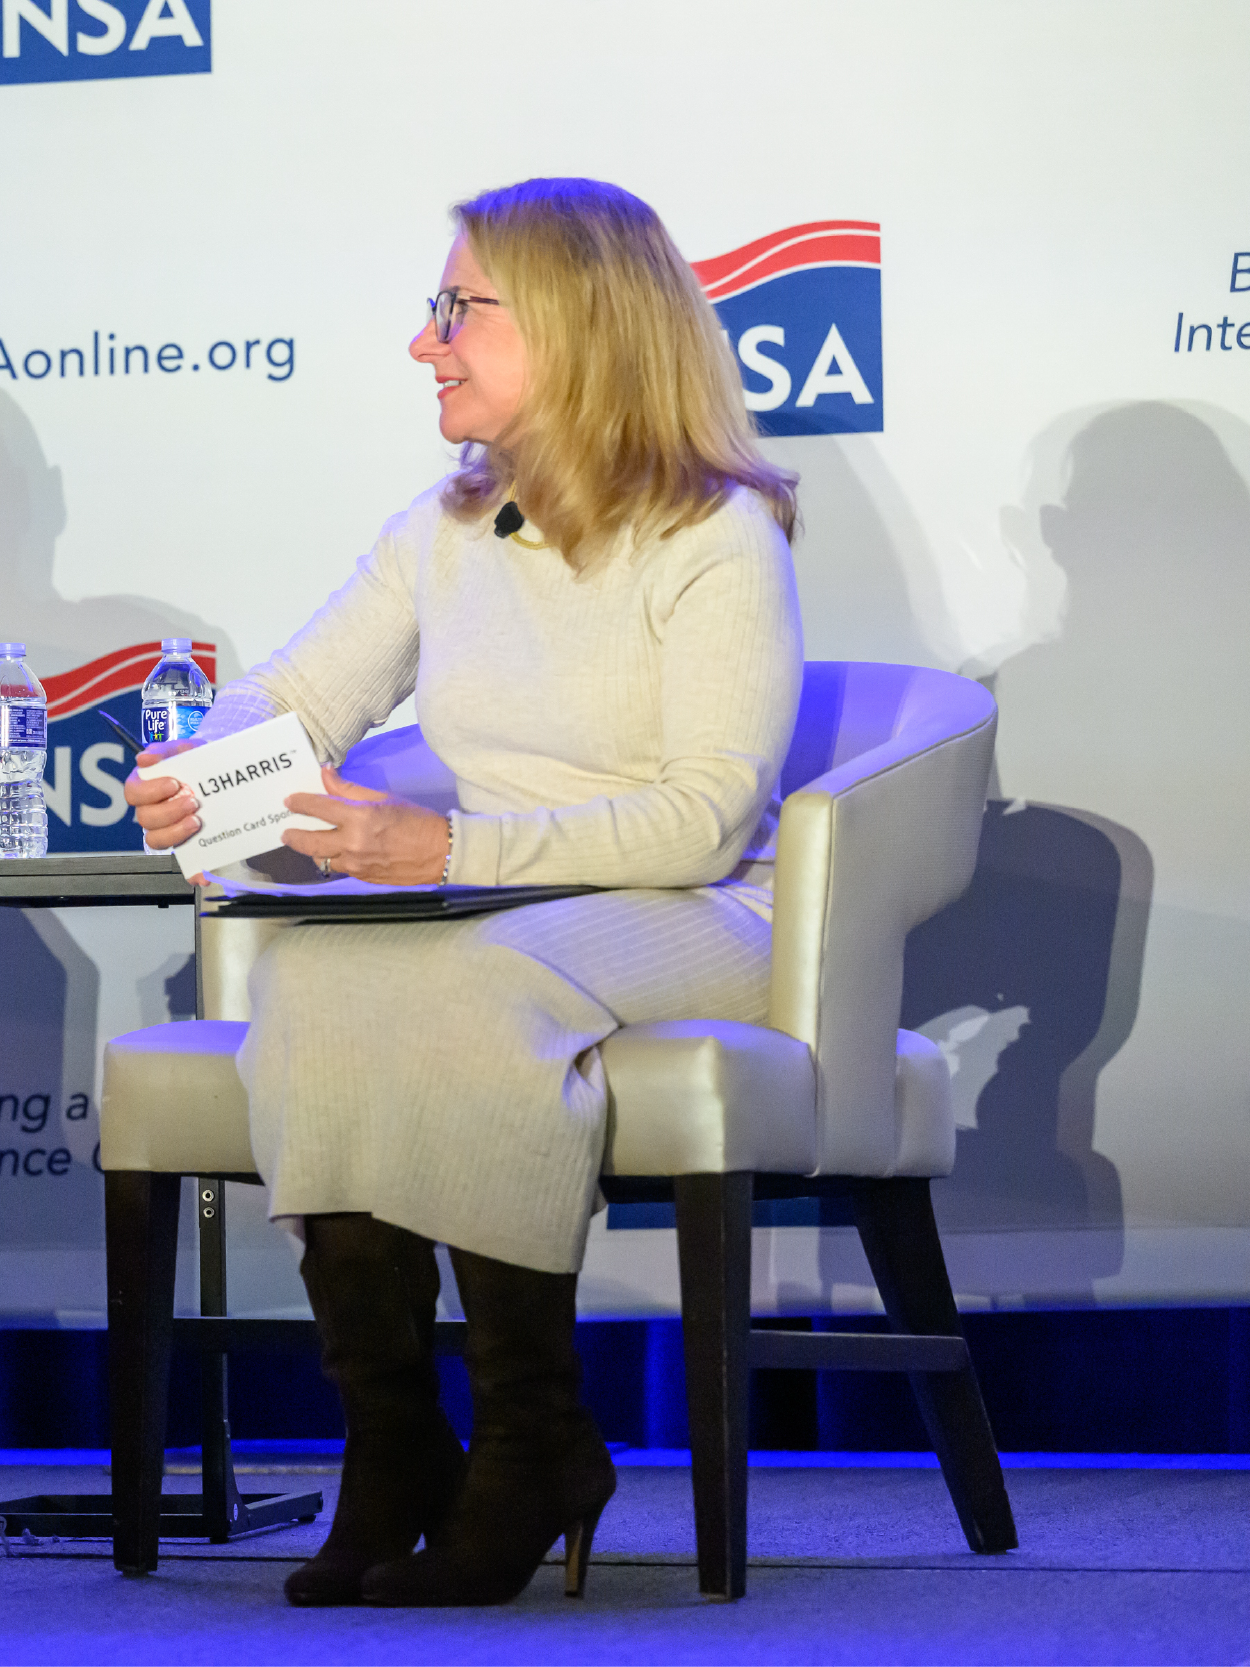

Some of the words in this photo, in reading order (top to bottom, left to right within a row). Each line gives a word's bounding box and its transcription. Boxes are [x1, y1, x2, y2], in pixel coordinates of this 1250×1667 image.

[721, 323, 875, 412] SA
[145, 709, 168, 720] Pure
[147, 719, 165, 733] Life
[198, 828, 242, 847] Question
[243, 816, 267, 832] Card
[66, 1092, 89, 1121] a
